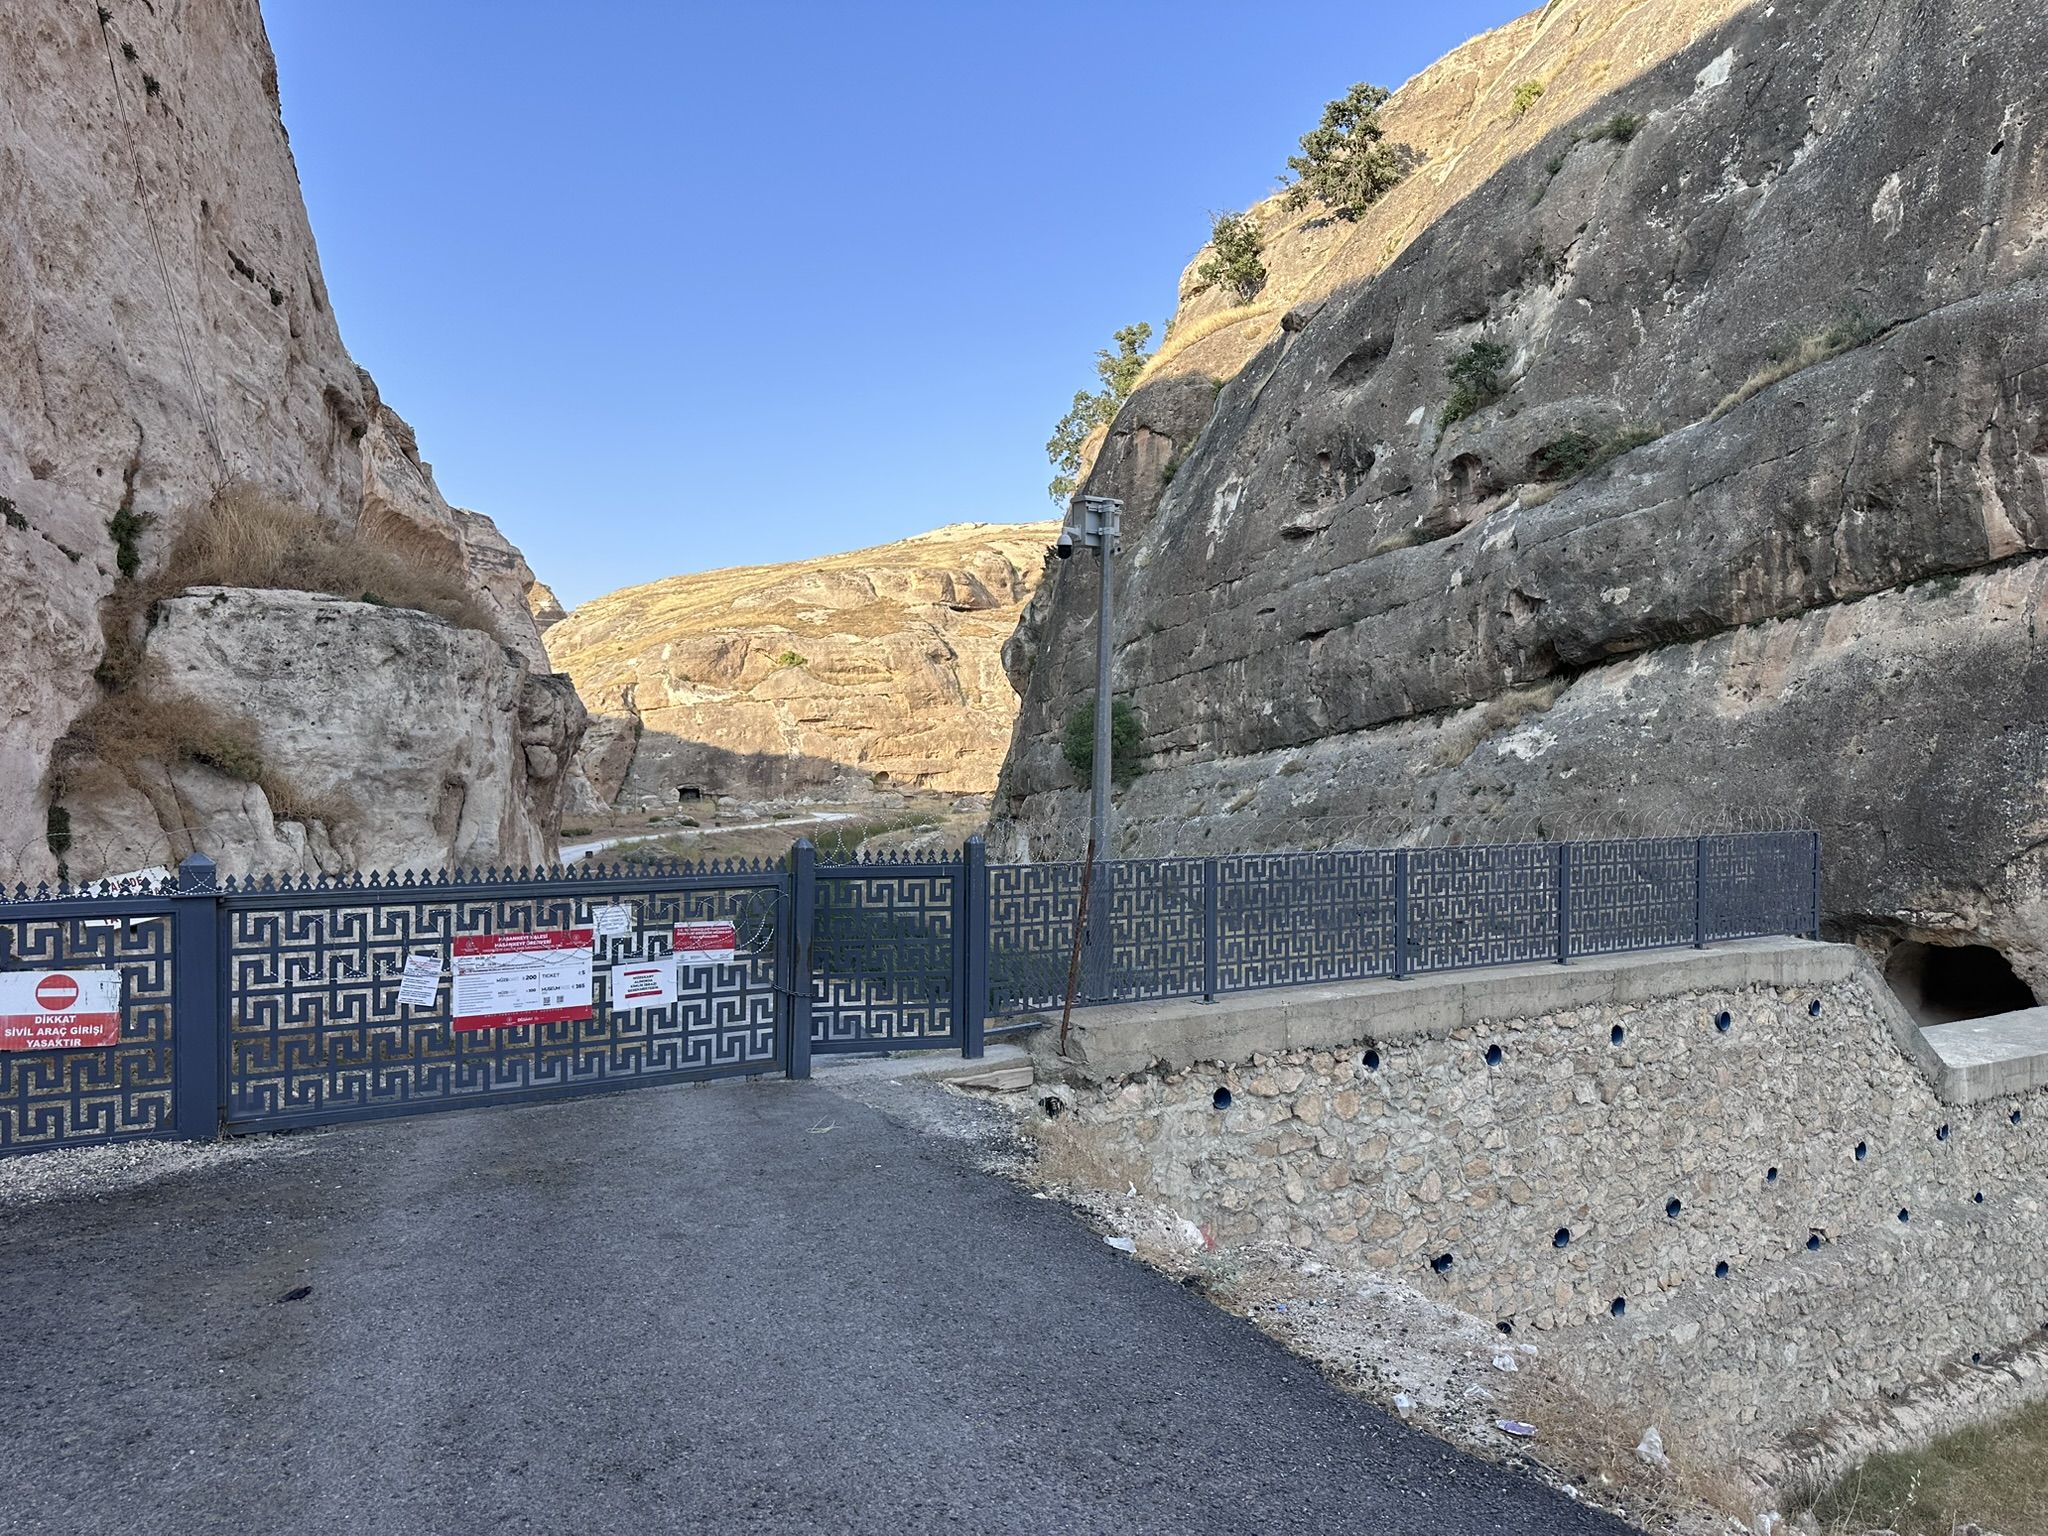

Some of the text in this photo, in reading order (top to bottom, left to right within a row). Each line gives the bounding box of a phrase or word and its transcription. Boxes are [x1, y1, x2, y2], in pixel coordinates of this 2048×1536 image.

[35, 1014, 76, 1024] DİKKAT
[4, 1024, 103, 1037] SİVİL ARAÇ GİRİŞİ
[26, 1038, 81, 1048] YASAKTIR
